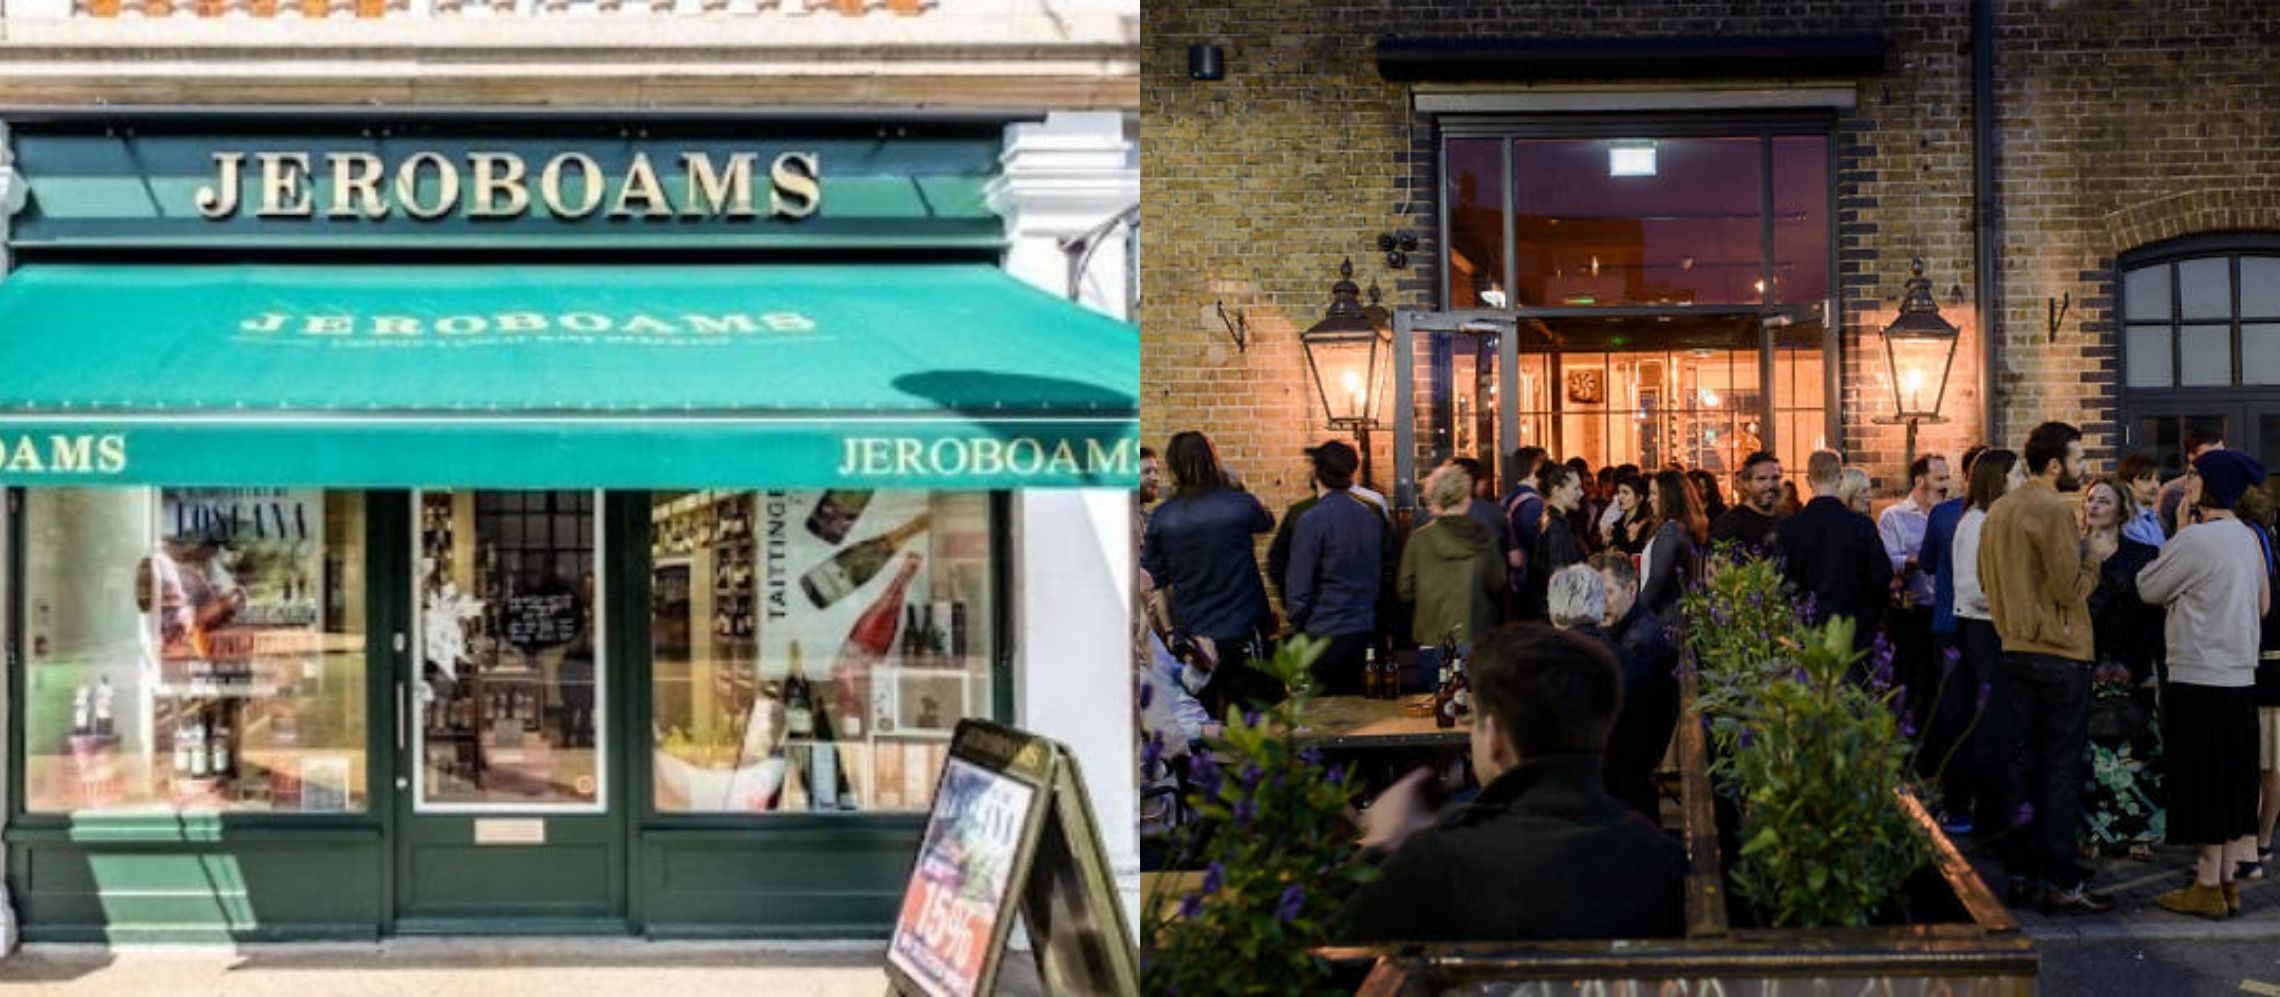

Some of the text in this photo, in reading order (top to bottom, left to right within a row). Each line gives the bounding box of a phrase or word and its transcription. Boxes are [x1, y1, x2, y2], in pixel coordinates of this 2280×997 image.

[195, 151, 821, 219] JEROBOAMS
[239, 312, 816, 337] JEROBOAMS
[0, 435, 126, 473] AMS
[837, 437, 1140, 476] JEROBOAM
